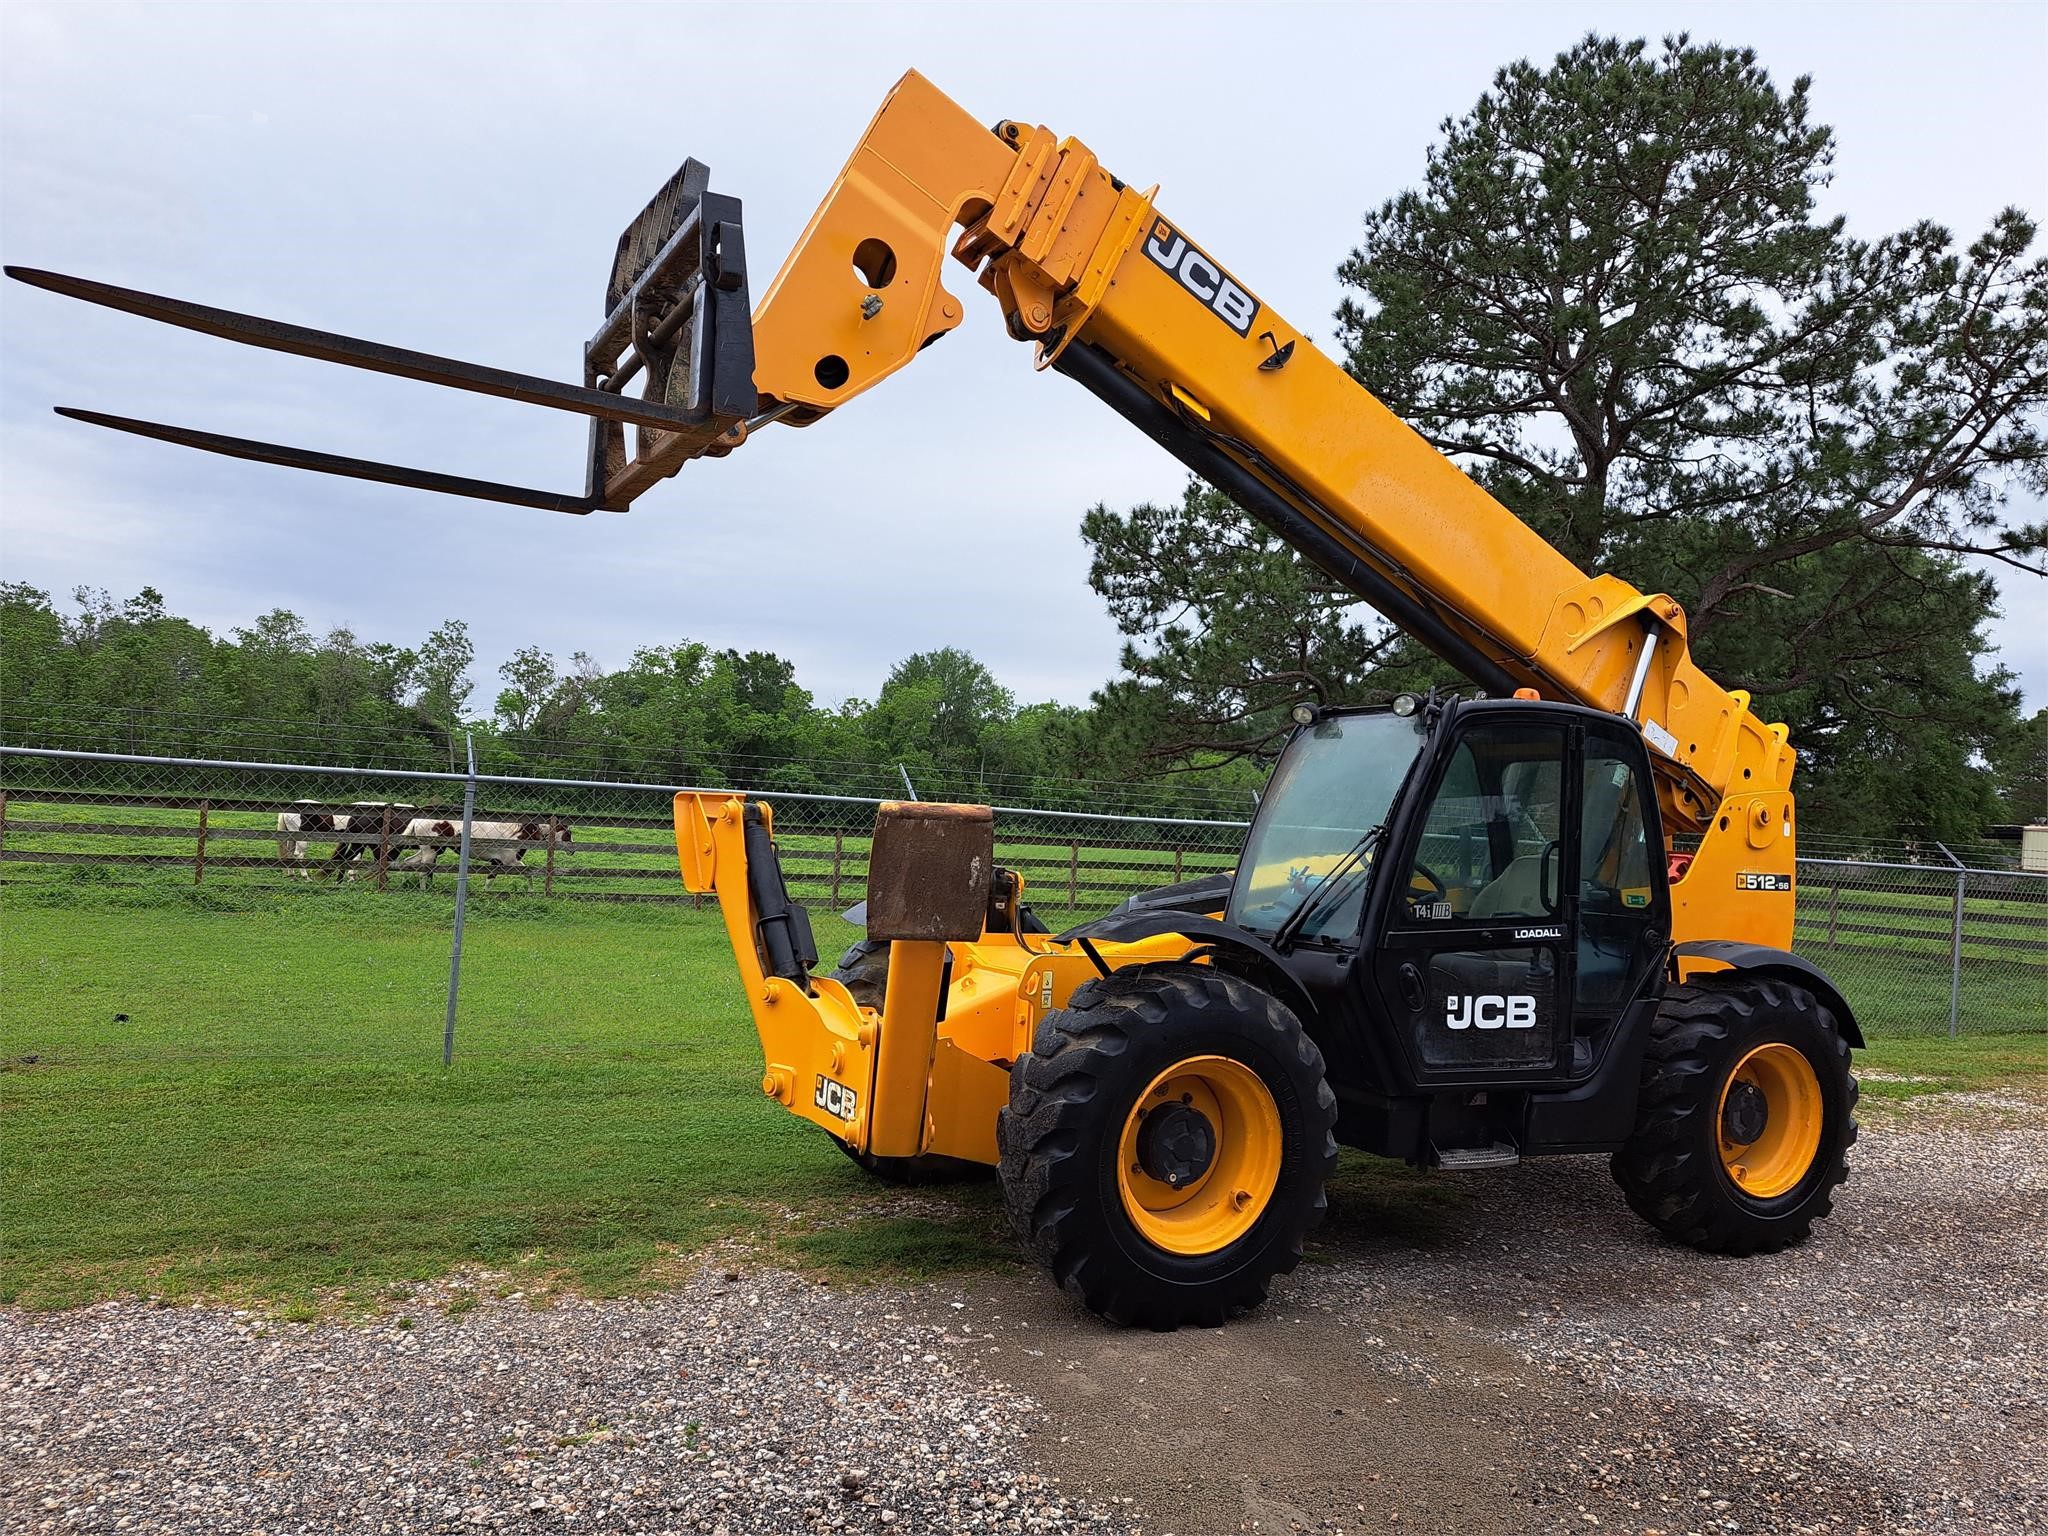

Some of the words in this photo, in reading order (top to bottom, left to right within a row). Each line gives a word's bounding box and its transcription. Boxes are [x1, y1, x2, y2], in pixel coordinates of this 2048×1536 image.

[1147, 236, 1254, 331] JCB
[1515, 928, 1561, 939] LOADALL
[1446, 995, 1537, 1030] JCB
[815, 1078, 857, 1120] JCB
